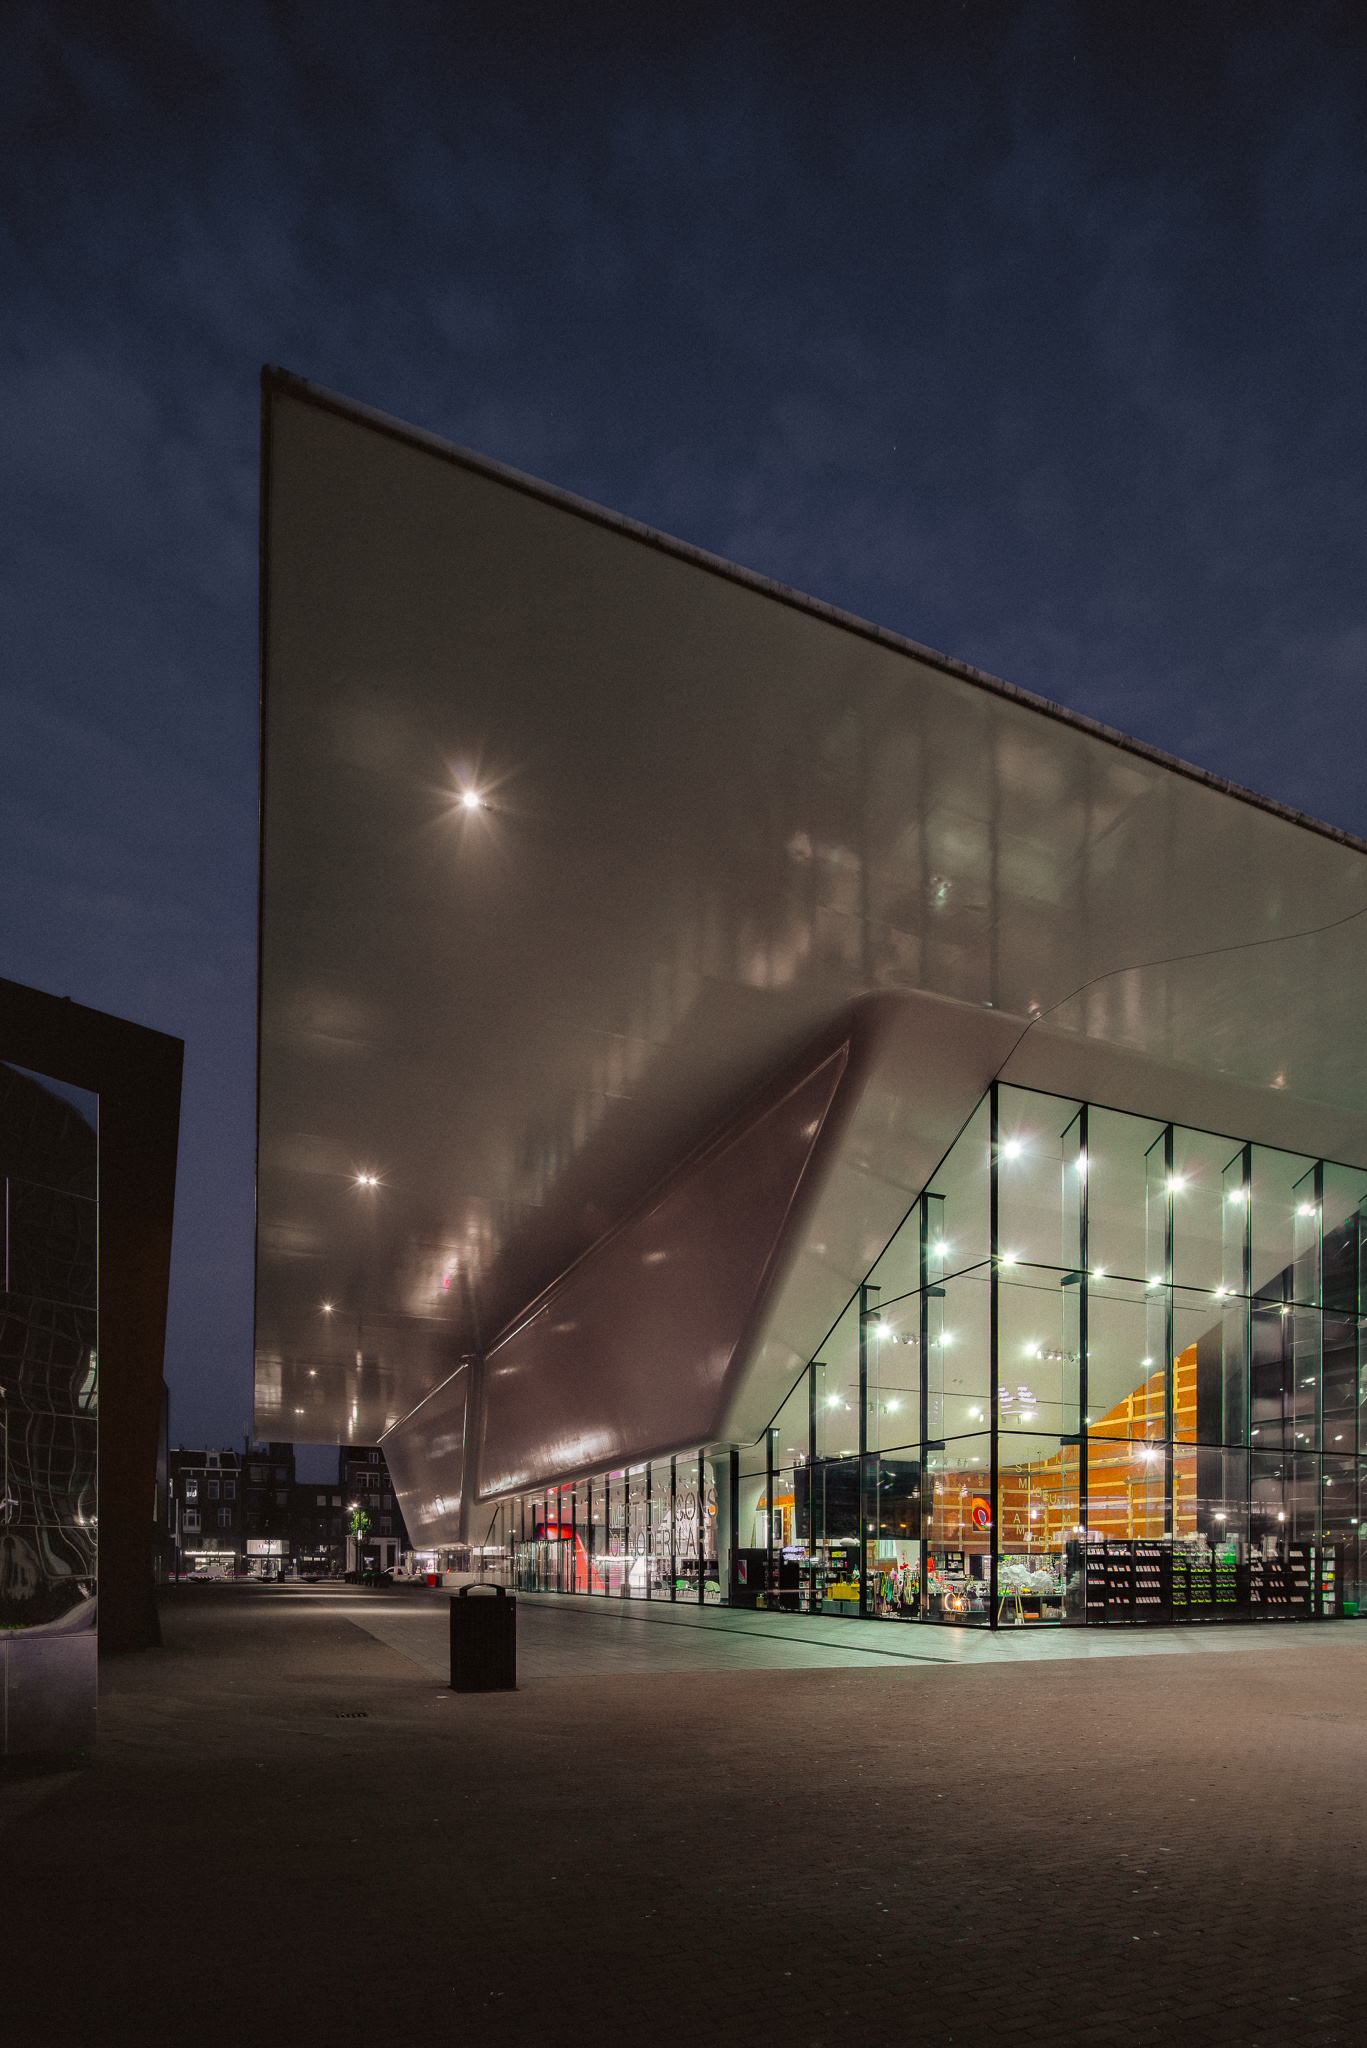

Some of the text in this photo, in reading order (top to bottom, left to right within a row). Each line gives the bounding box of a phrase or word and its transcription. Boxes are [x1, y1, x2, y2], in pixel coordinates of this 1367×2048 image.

[644, 1496, 668, 1526] THE
[671, 1487, 718, 1523] ICONS
[1018, 1478, 1065, 1509] MUSEUM
[686, 1524, 717, 1556] ART
